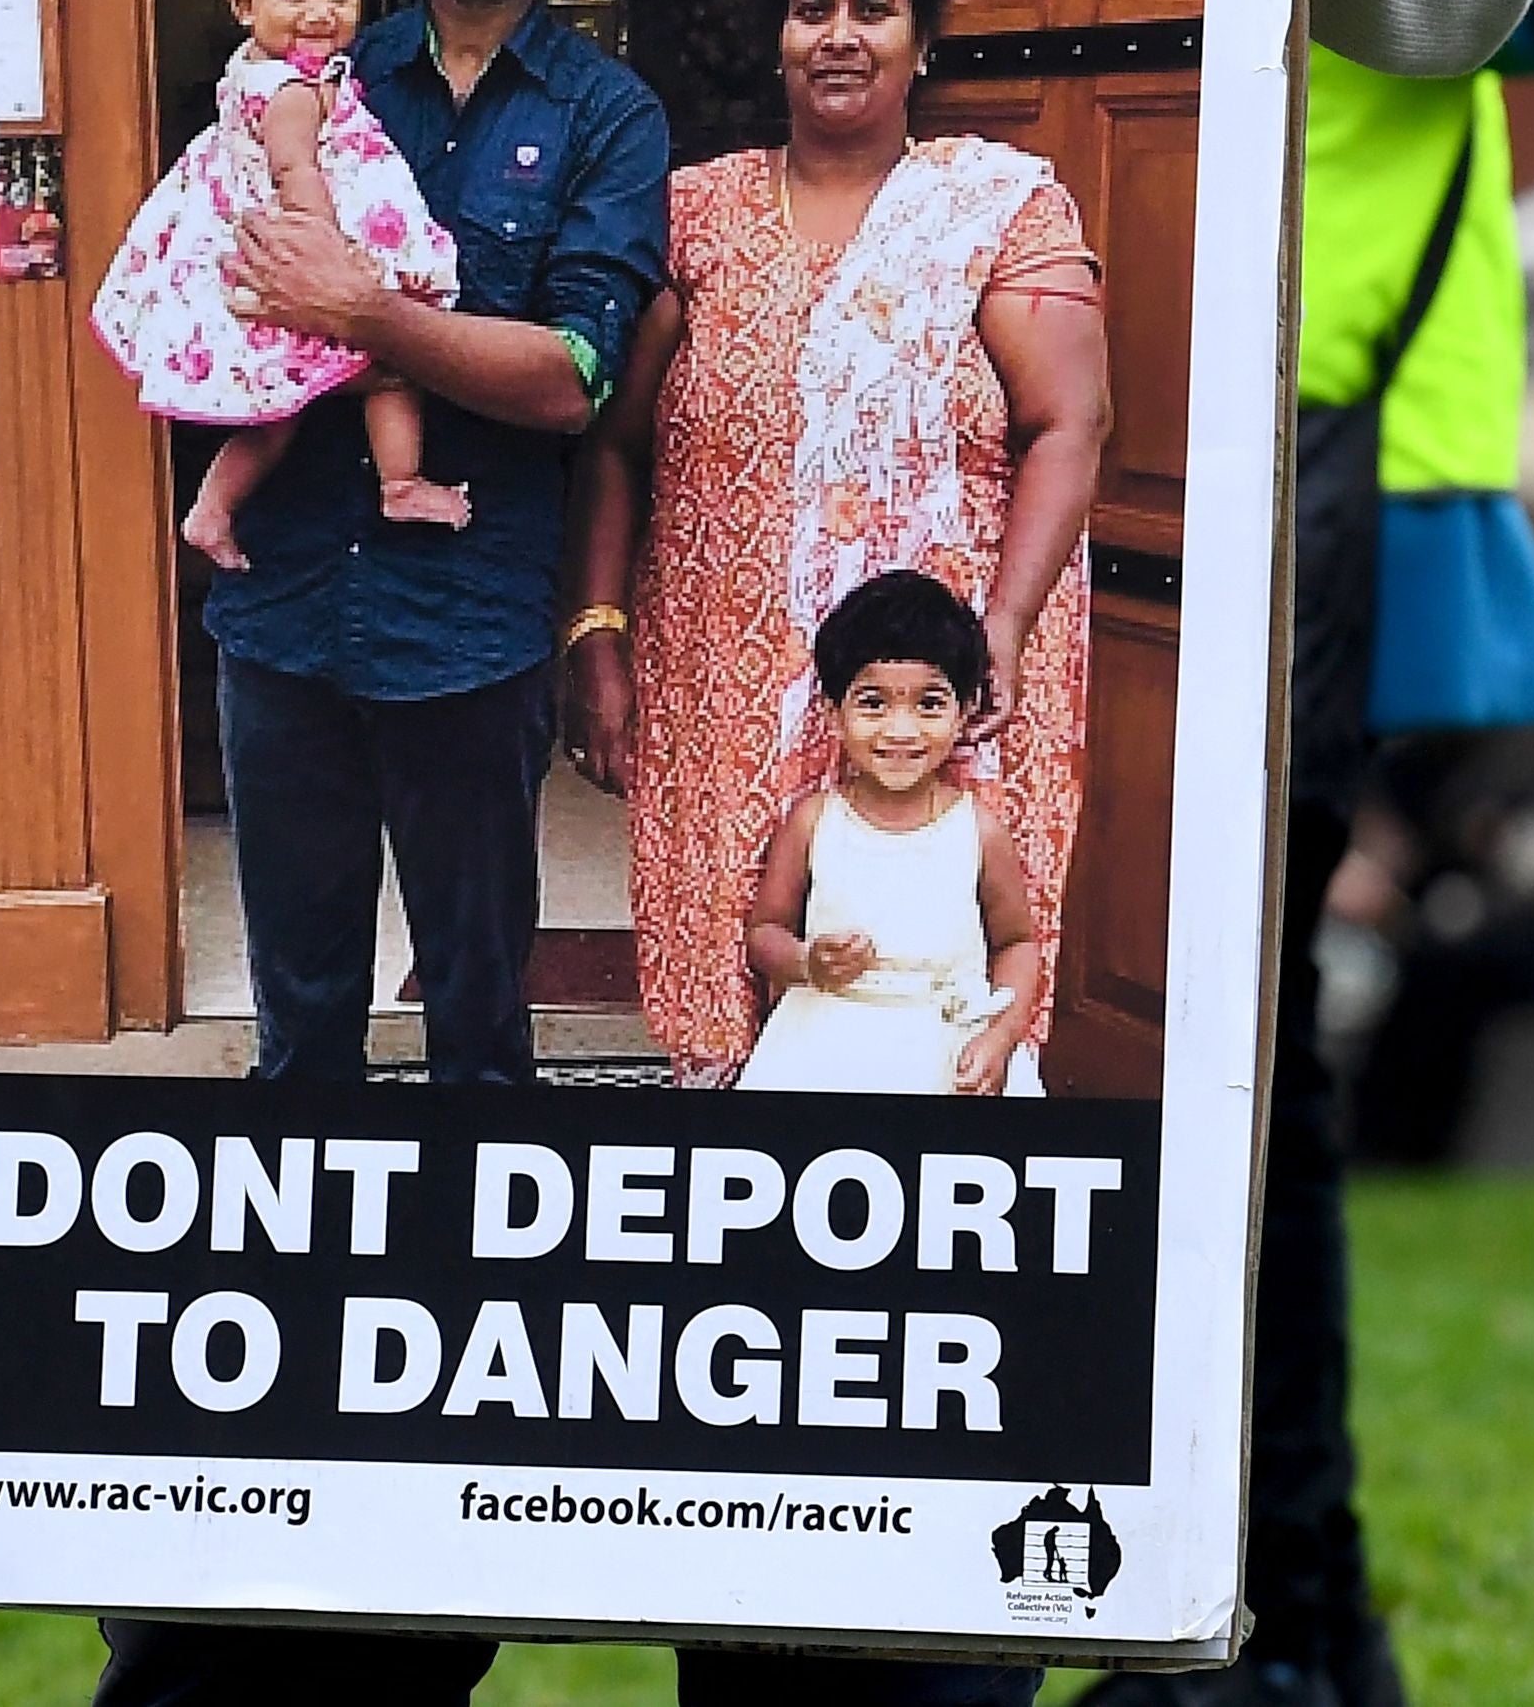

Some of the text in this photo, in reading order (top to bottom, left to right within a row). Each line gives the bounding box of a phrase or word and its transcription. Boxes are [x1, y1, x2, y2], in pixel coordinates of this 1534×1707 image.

[471, 1142, 1123, 1274] DEPORT
[74, 1290, 1003, 1432] TO DANGER
[460, 1481, 912, 1534] facebook.com/racvic
[1006, 1591, 1073, 1603] Refugee Action
[1007, 1602, 1073, 1613] Collective (Vic)
